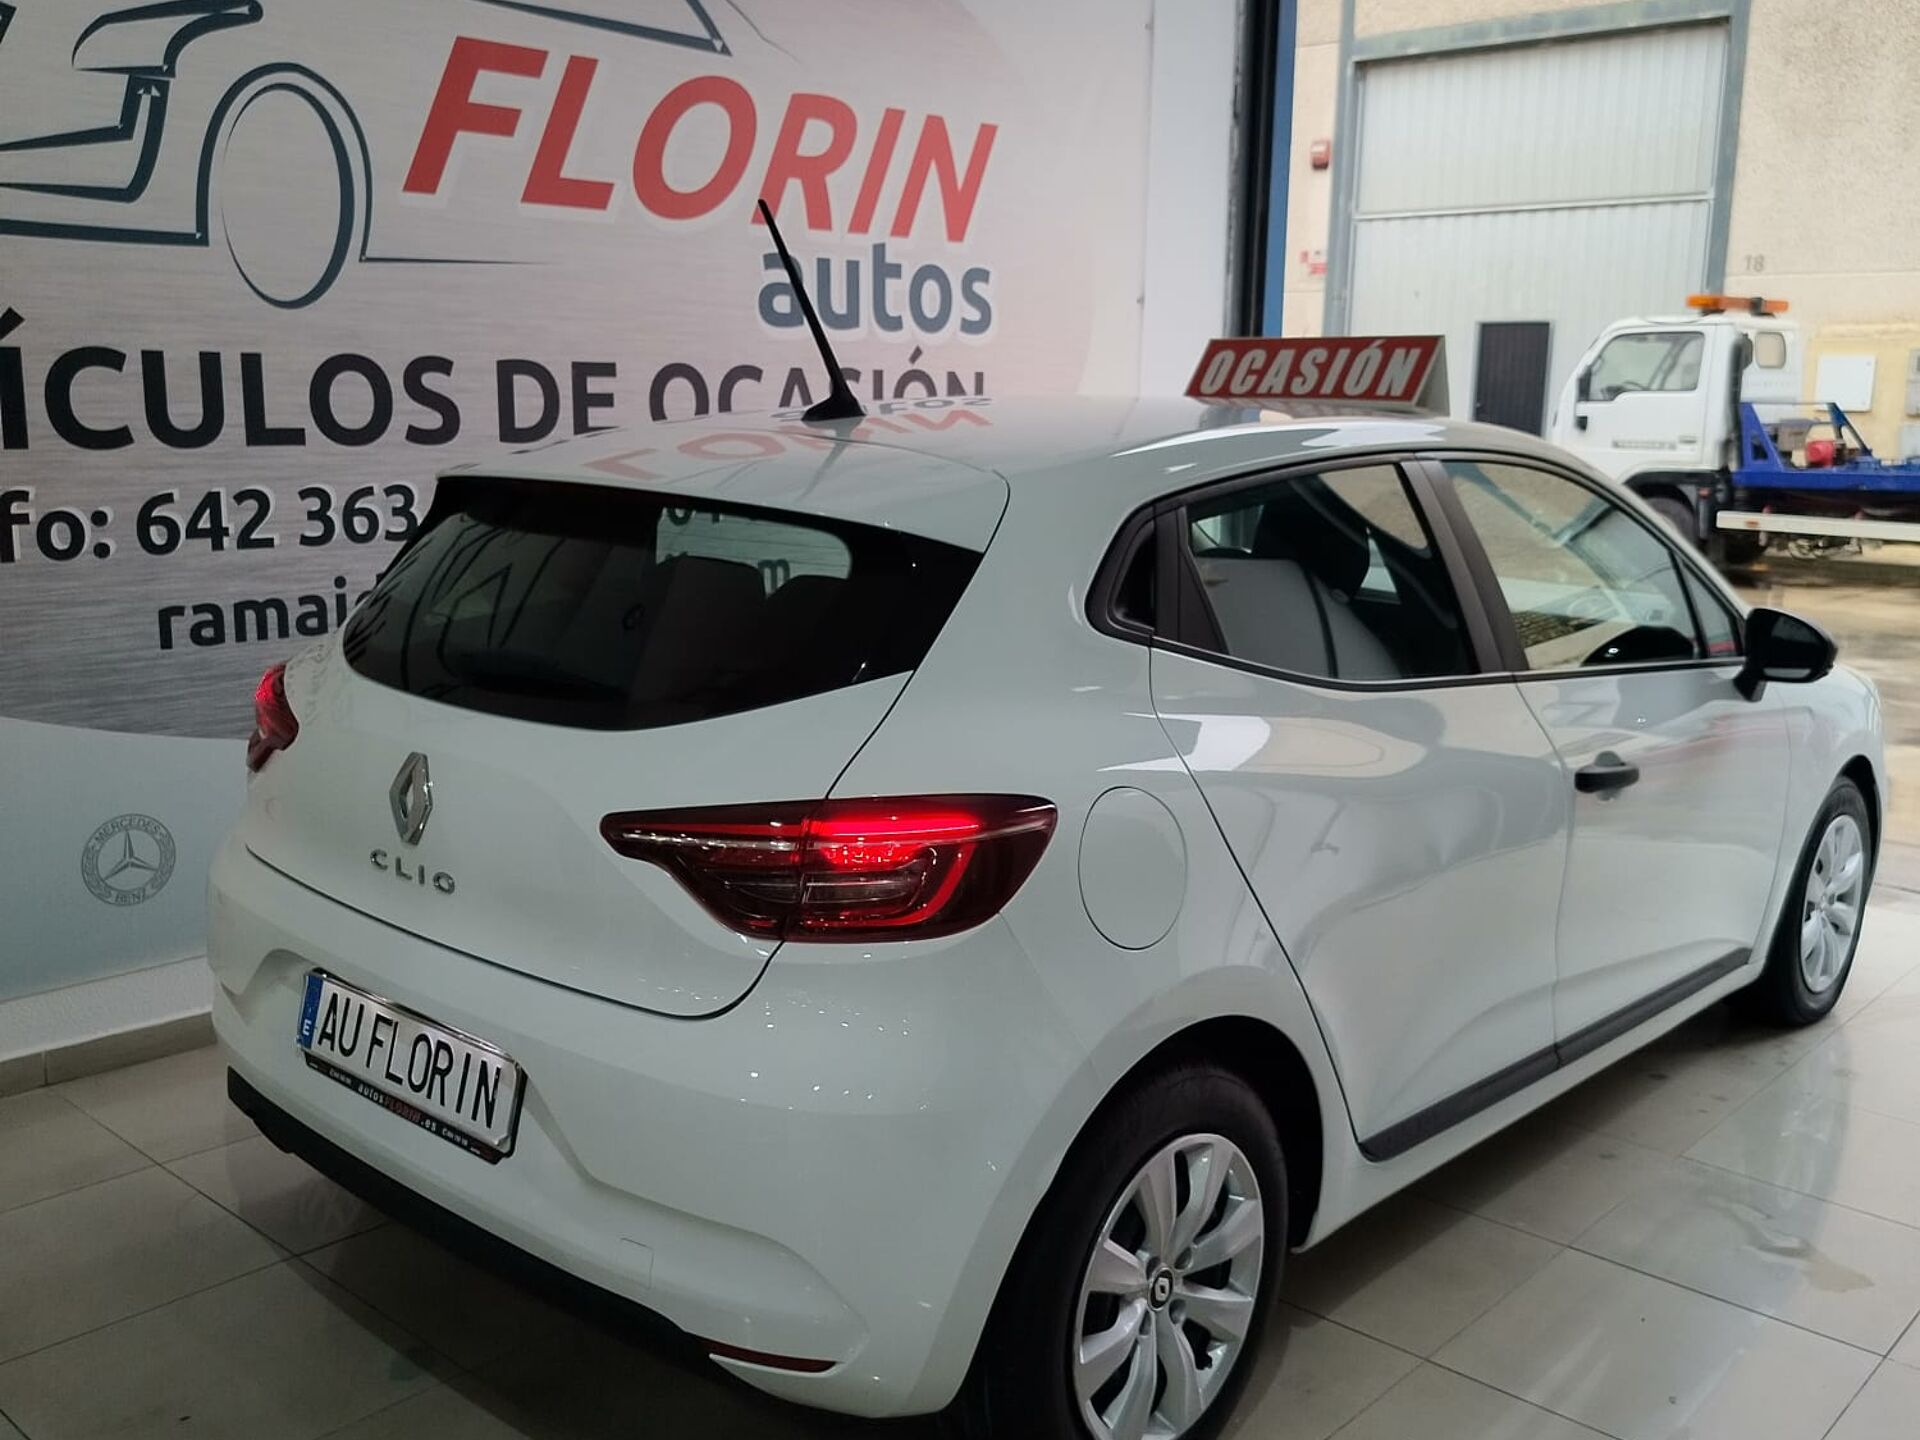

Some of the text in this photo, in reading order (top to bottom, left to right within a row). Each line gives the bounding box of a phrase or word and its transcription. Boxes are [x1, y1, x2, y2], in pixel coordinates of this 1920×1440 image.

[402, 36, 998, 243] FLORIN
[758, 242, 992, 335] autos
[1744, 253, 1764, 272] 18
[496, 359, 618, 444] DE
[1199, 339, 1422, 398] OCASIÓN
[136, 490, 275, 556] 642
[298, 484, 419, 547] 363
[157, 573, 386, 650] ramai
[369, 849, 456, 895] CLIO
[302, 1018, 313, 1036] E
[317, 992, 502, 1129] AU FLORIN
